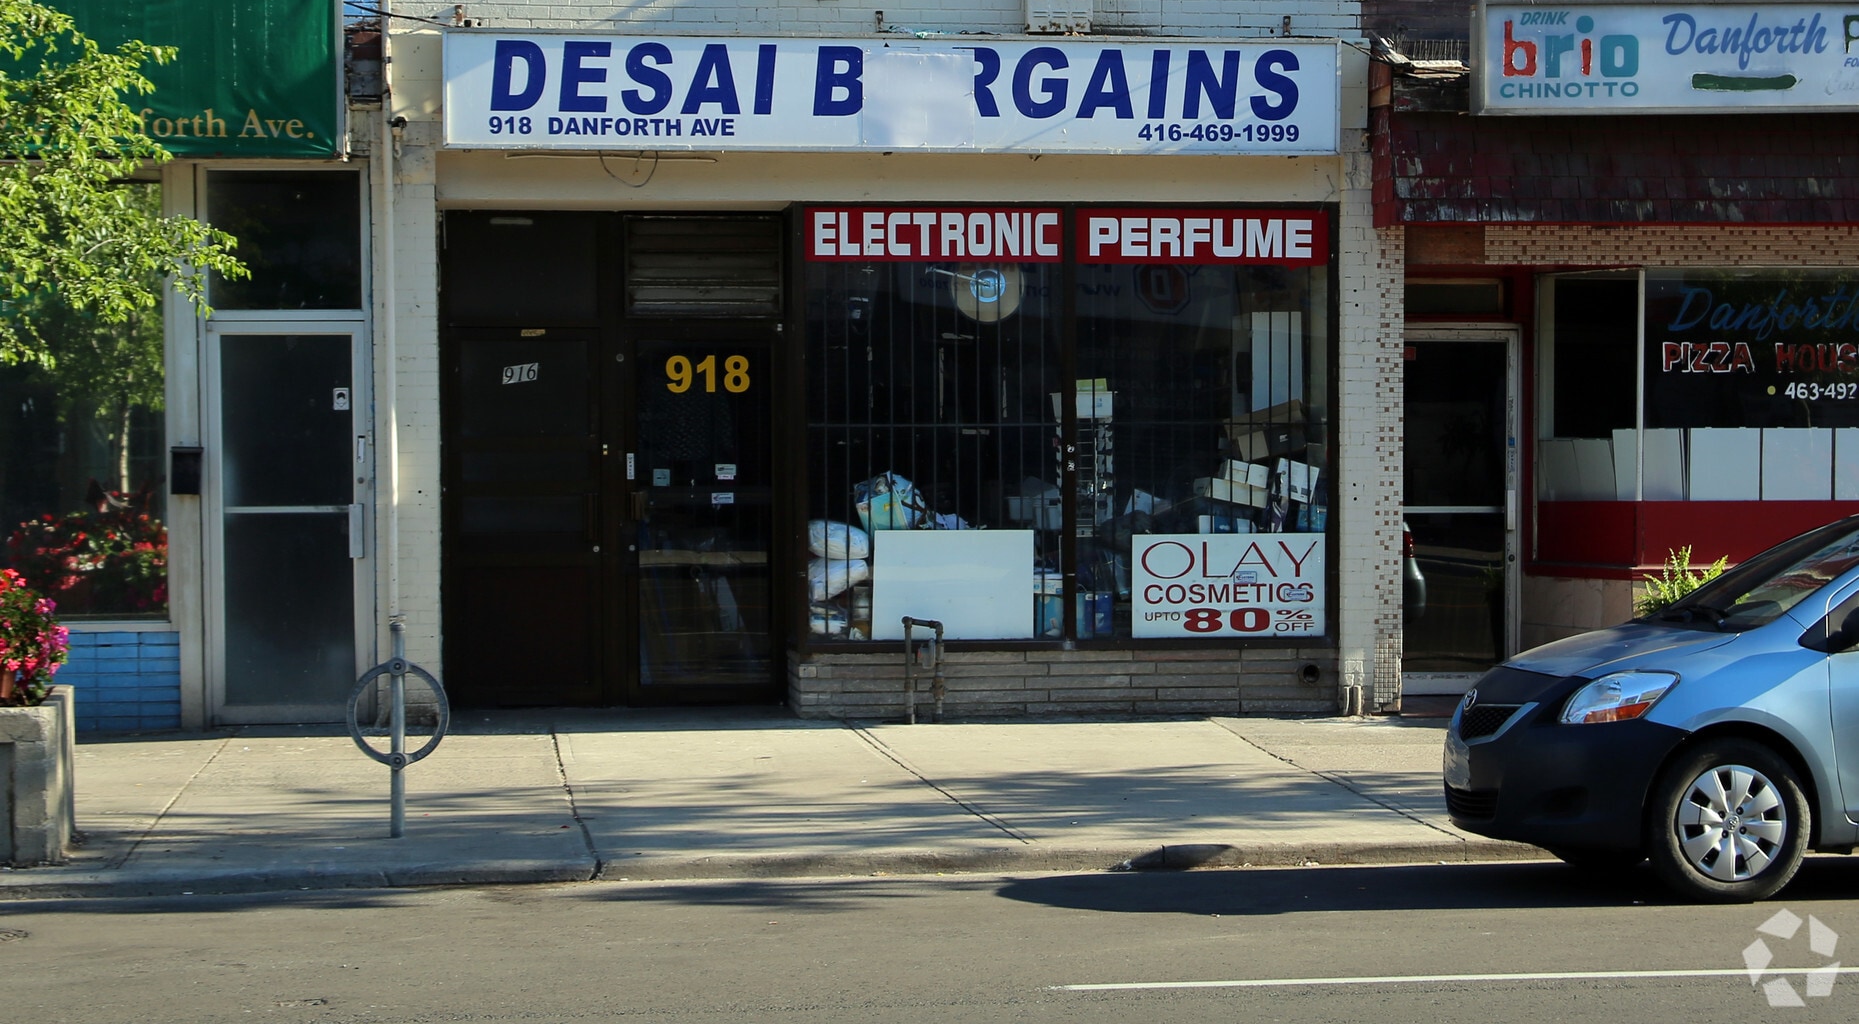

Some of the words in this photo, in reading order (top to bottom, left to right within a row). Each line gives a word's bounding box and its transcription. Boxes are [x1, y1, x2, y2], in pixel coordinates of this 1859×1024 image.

[1520, 11, 1570, 26] DRINK
[1502, 15, 1639, 78] brio
[1662, 12, 1829, 70] Danforth
[1844, 57, 1859, 69] FO
[490, 39, 776, 115] DESAI
[812, 45, 1300, 121] BRGAINS
[1500, 81, 1640, 99] CHINOTTO
[237, 108, 315, 139] Ave.
[489, 116, 532, 135] 918
[548, 118, 682, 137] DANFORTH
[690, 119, 736, 137] AVE
[1138, 123, 1300, 143] 416-469-1999
[814, 211, 1059, 256] ELECTRONIC
[1089, 217, 1313, 258] PERFUME
[1662, 342, 1756, 374] PIZZA
[1775, 342, 1859, 374] HOUS
[504, 364, 537, 384] 916
[665, 355, 750, 393] 918
[1141, 541, 1317, 579] OLAY
[1144, 583, 1314, 605] COSMETICS
[1145, 611, 1181, 622] UPTO
[1275, 622, 1315, 633] OFF
